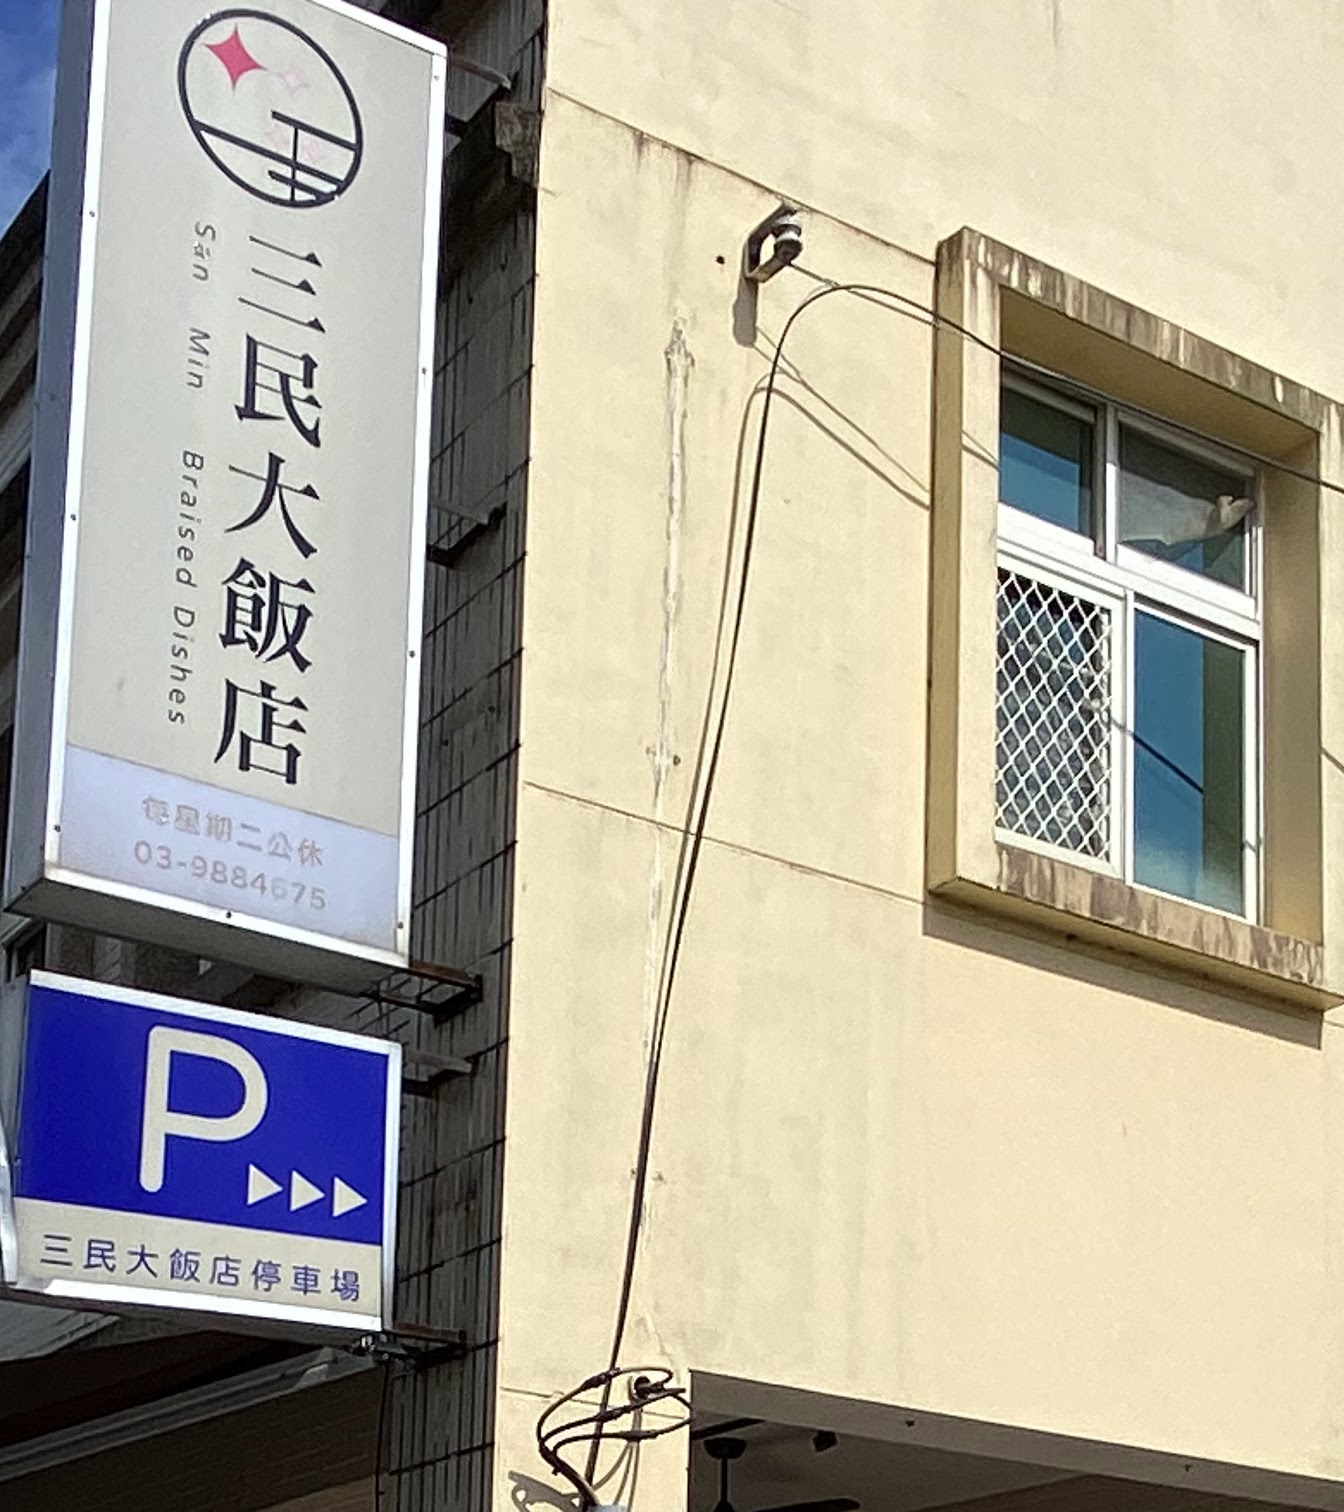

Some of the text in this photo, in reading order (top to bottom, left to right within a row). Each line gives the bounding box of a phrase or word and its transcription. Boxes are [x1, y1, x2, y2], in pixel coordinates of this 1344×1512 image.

[187, 326, 211, 389] Min
[175, 450, 205, 588] Braised
[213, 233, 327, 786] 三民大飯店
[168, 606, 196, 725] Dishes
[133, 840, 327, 910] 03-9884675
[142, 798, 324, 867] 每星期二公休
[139, 1024, 269, 1193] P
[39, 1232, 362, 1301] 三民大飯店停車場
